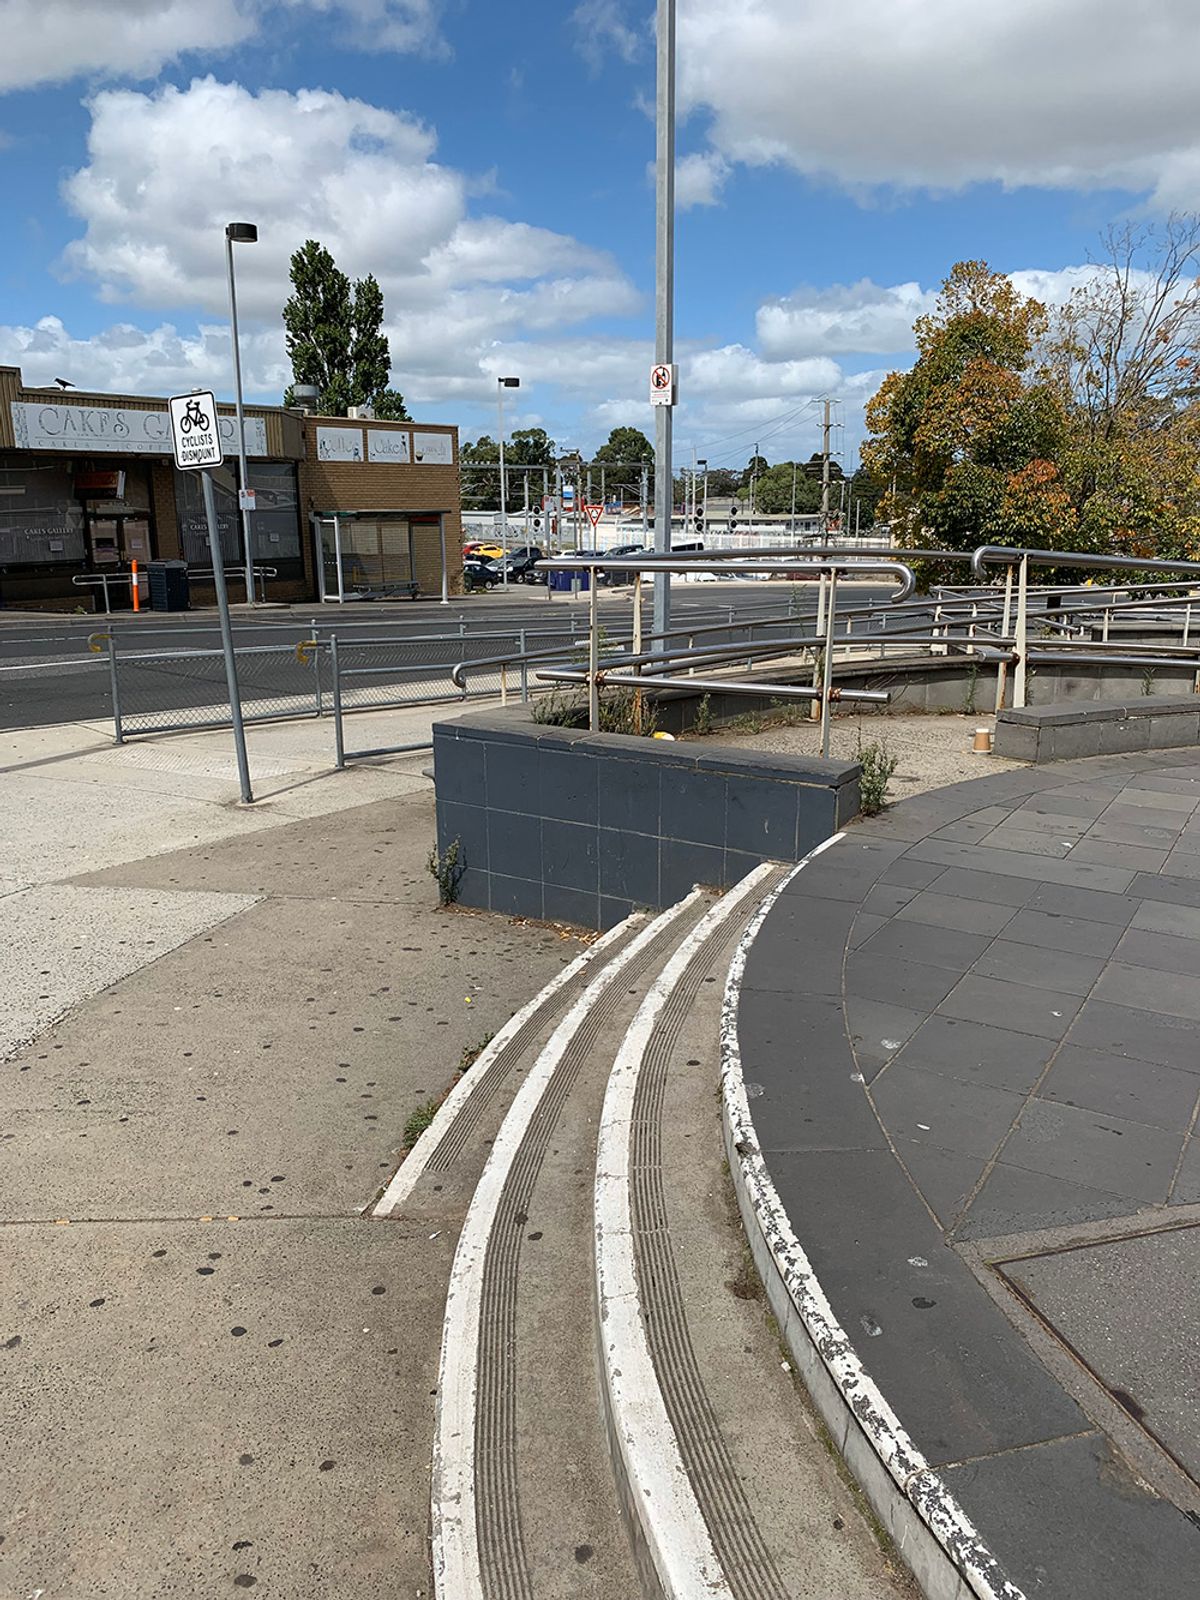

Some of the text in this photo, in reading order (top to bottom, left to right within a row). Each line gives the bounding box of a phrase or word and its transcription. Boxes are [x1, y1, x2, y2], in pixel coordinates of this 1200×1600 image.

[38, 407, 130, 438] CAKES
[181, 433, 214, 448] CYCLISTS
[181, 447, 216, 462] DISMOUNT
